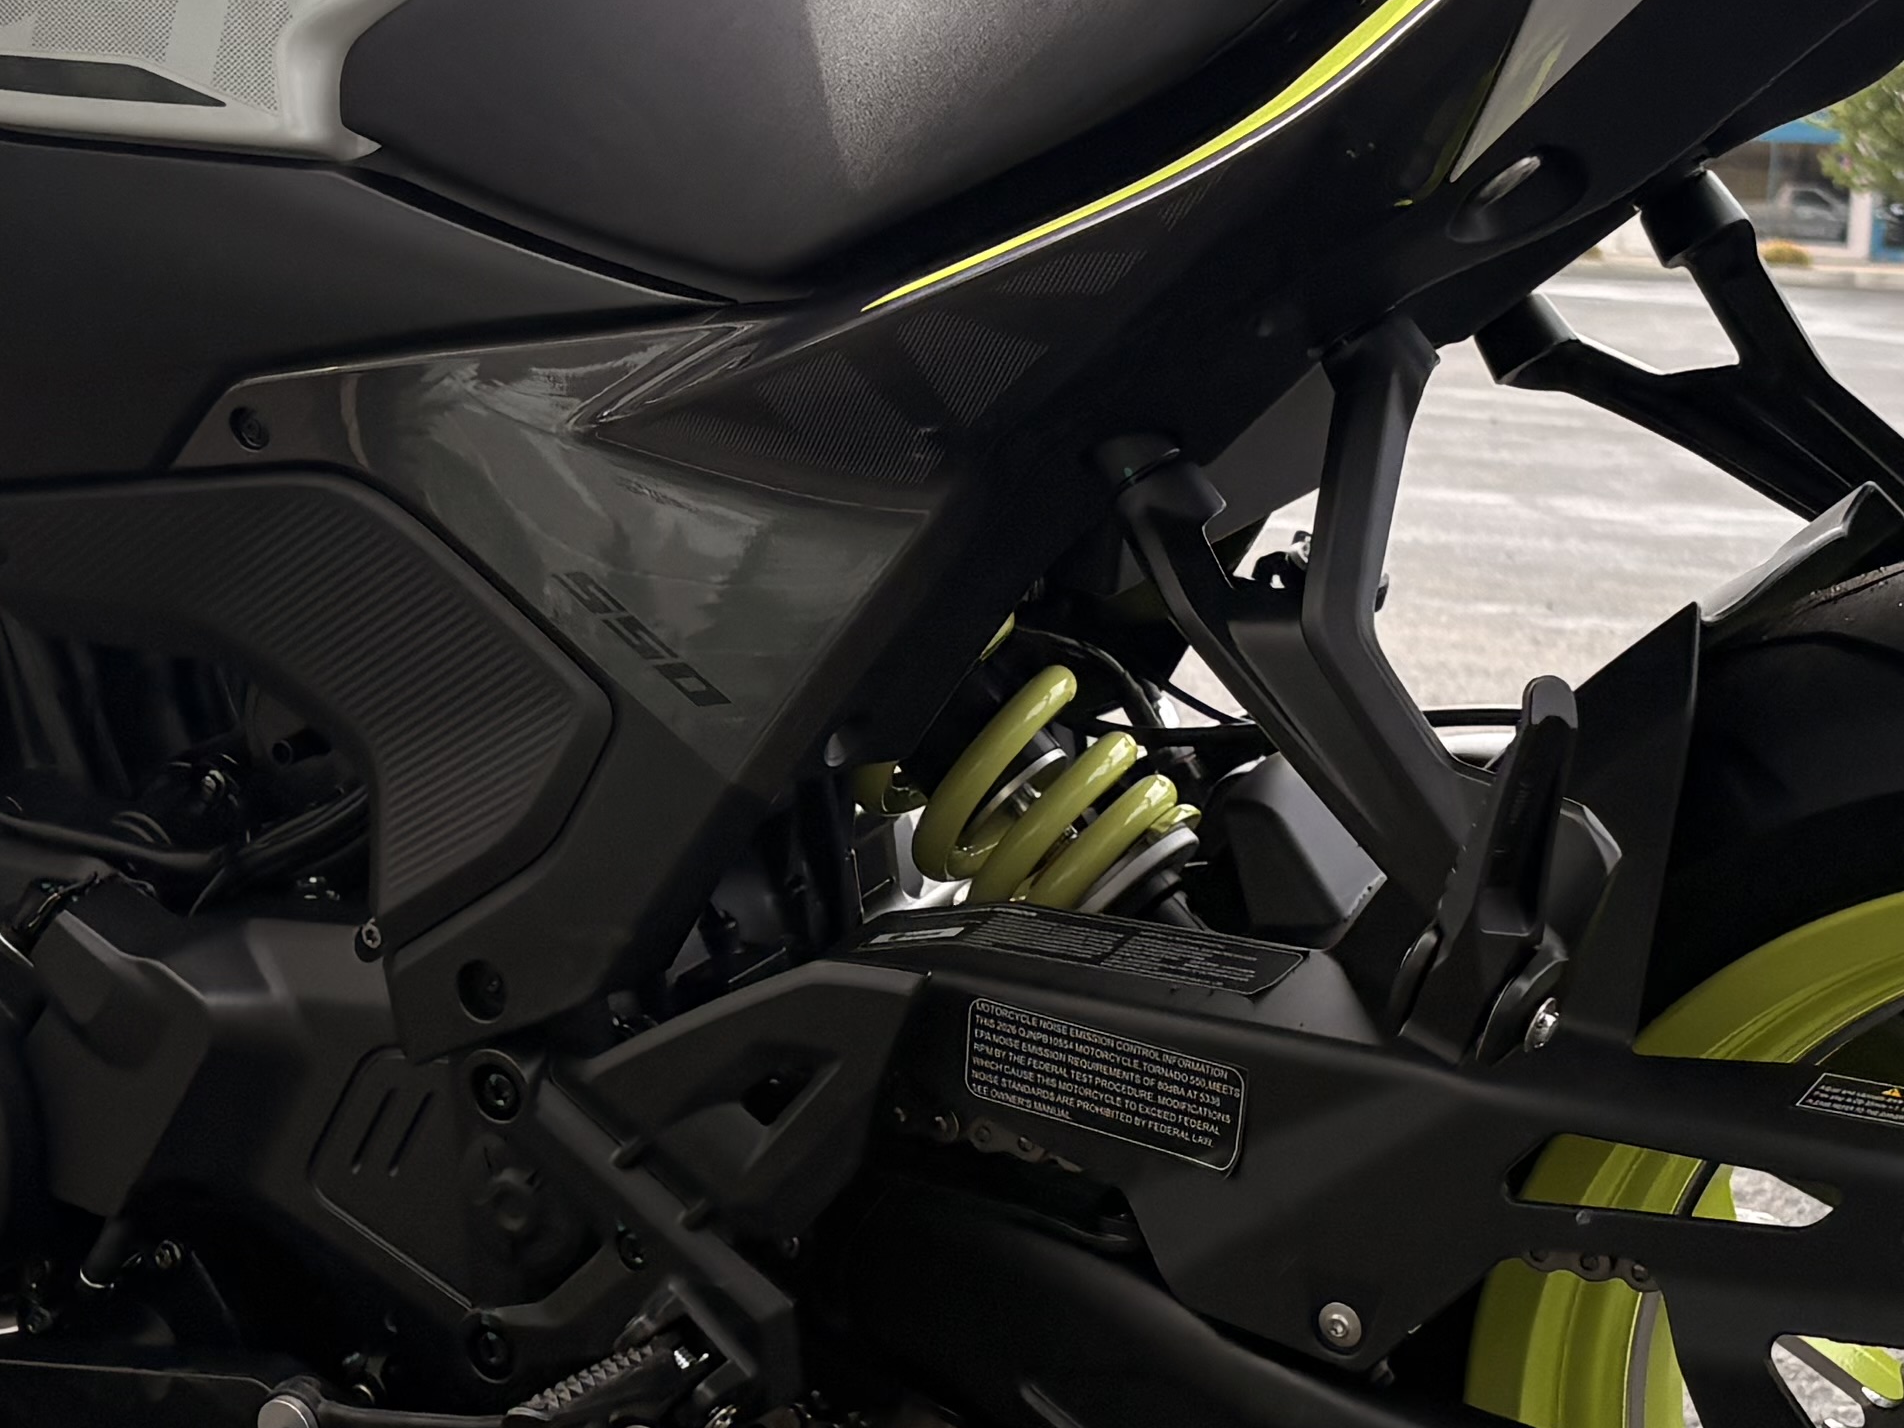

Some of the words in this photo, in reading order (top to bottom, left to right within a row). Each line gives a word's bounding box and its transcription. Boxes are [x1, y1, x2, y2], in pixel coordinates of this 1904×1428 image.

[551, 572, 733, 707] 550
[976, 1000, 1037, 1027] MOTORCYCLE
[1039, 1018, 1067, 1035] NOISE
[1069, 1026, 1113, 1048] EMISSION
[1116, 1039, 1160, 1061] CONTROL
[1162, 1051, 1227, 1081] INFORMATION
[992, 1033, 1019, 1050] NOISE
[1021, 1041, 1065, 1063] EMISSION
[1067, 1054, 1140, 1085] REQUIREMENTS
[1142, 1075, 1155, 1088] OF
[1186, 1088, 1197, 1100] AT
[1143, 1061, 1188, 1084] TORNADO
[994, 1047, 1005, 1059] BY
[1009, 1051, 1025, 1065] THE
[1027, 1057, 1068, 1078] FEDERAL
[1070, 1069, 1093, 1085] TEST
[1157, 1093, 1230, 1124] MODIFICATIONS
[1000, 1076, 1055, 1102] STANDARDS
[1056, 1092, 1074, 1107] ARE
[1133, 1116, 1146, 1128] BY
[1147, 1119, 1190, 1141] FEDERAL
[1003, 1064, 1034, 1081] CAUSE
[1036, 1073, 1056, 1088] THIS
[1058, 1079, 1121, 1107] MOTORCYCLE
[1124, 1099, 1137, 1111] TO
[1138, 1103, 1176, 1123] EXCEED
[1177, 1114, 1220, 1136] FEDERAL
